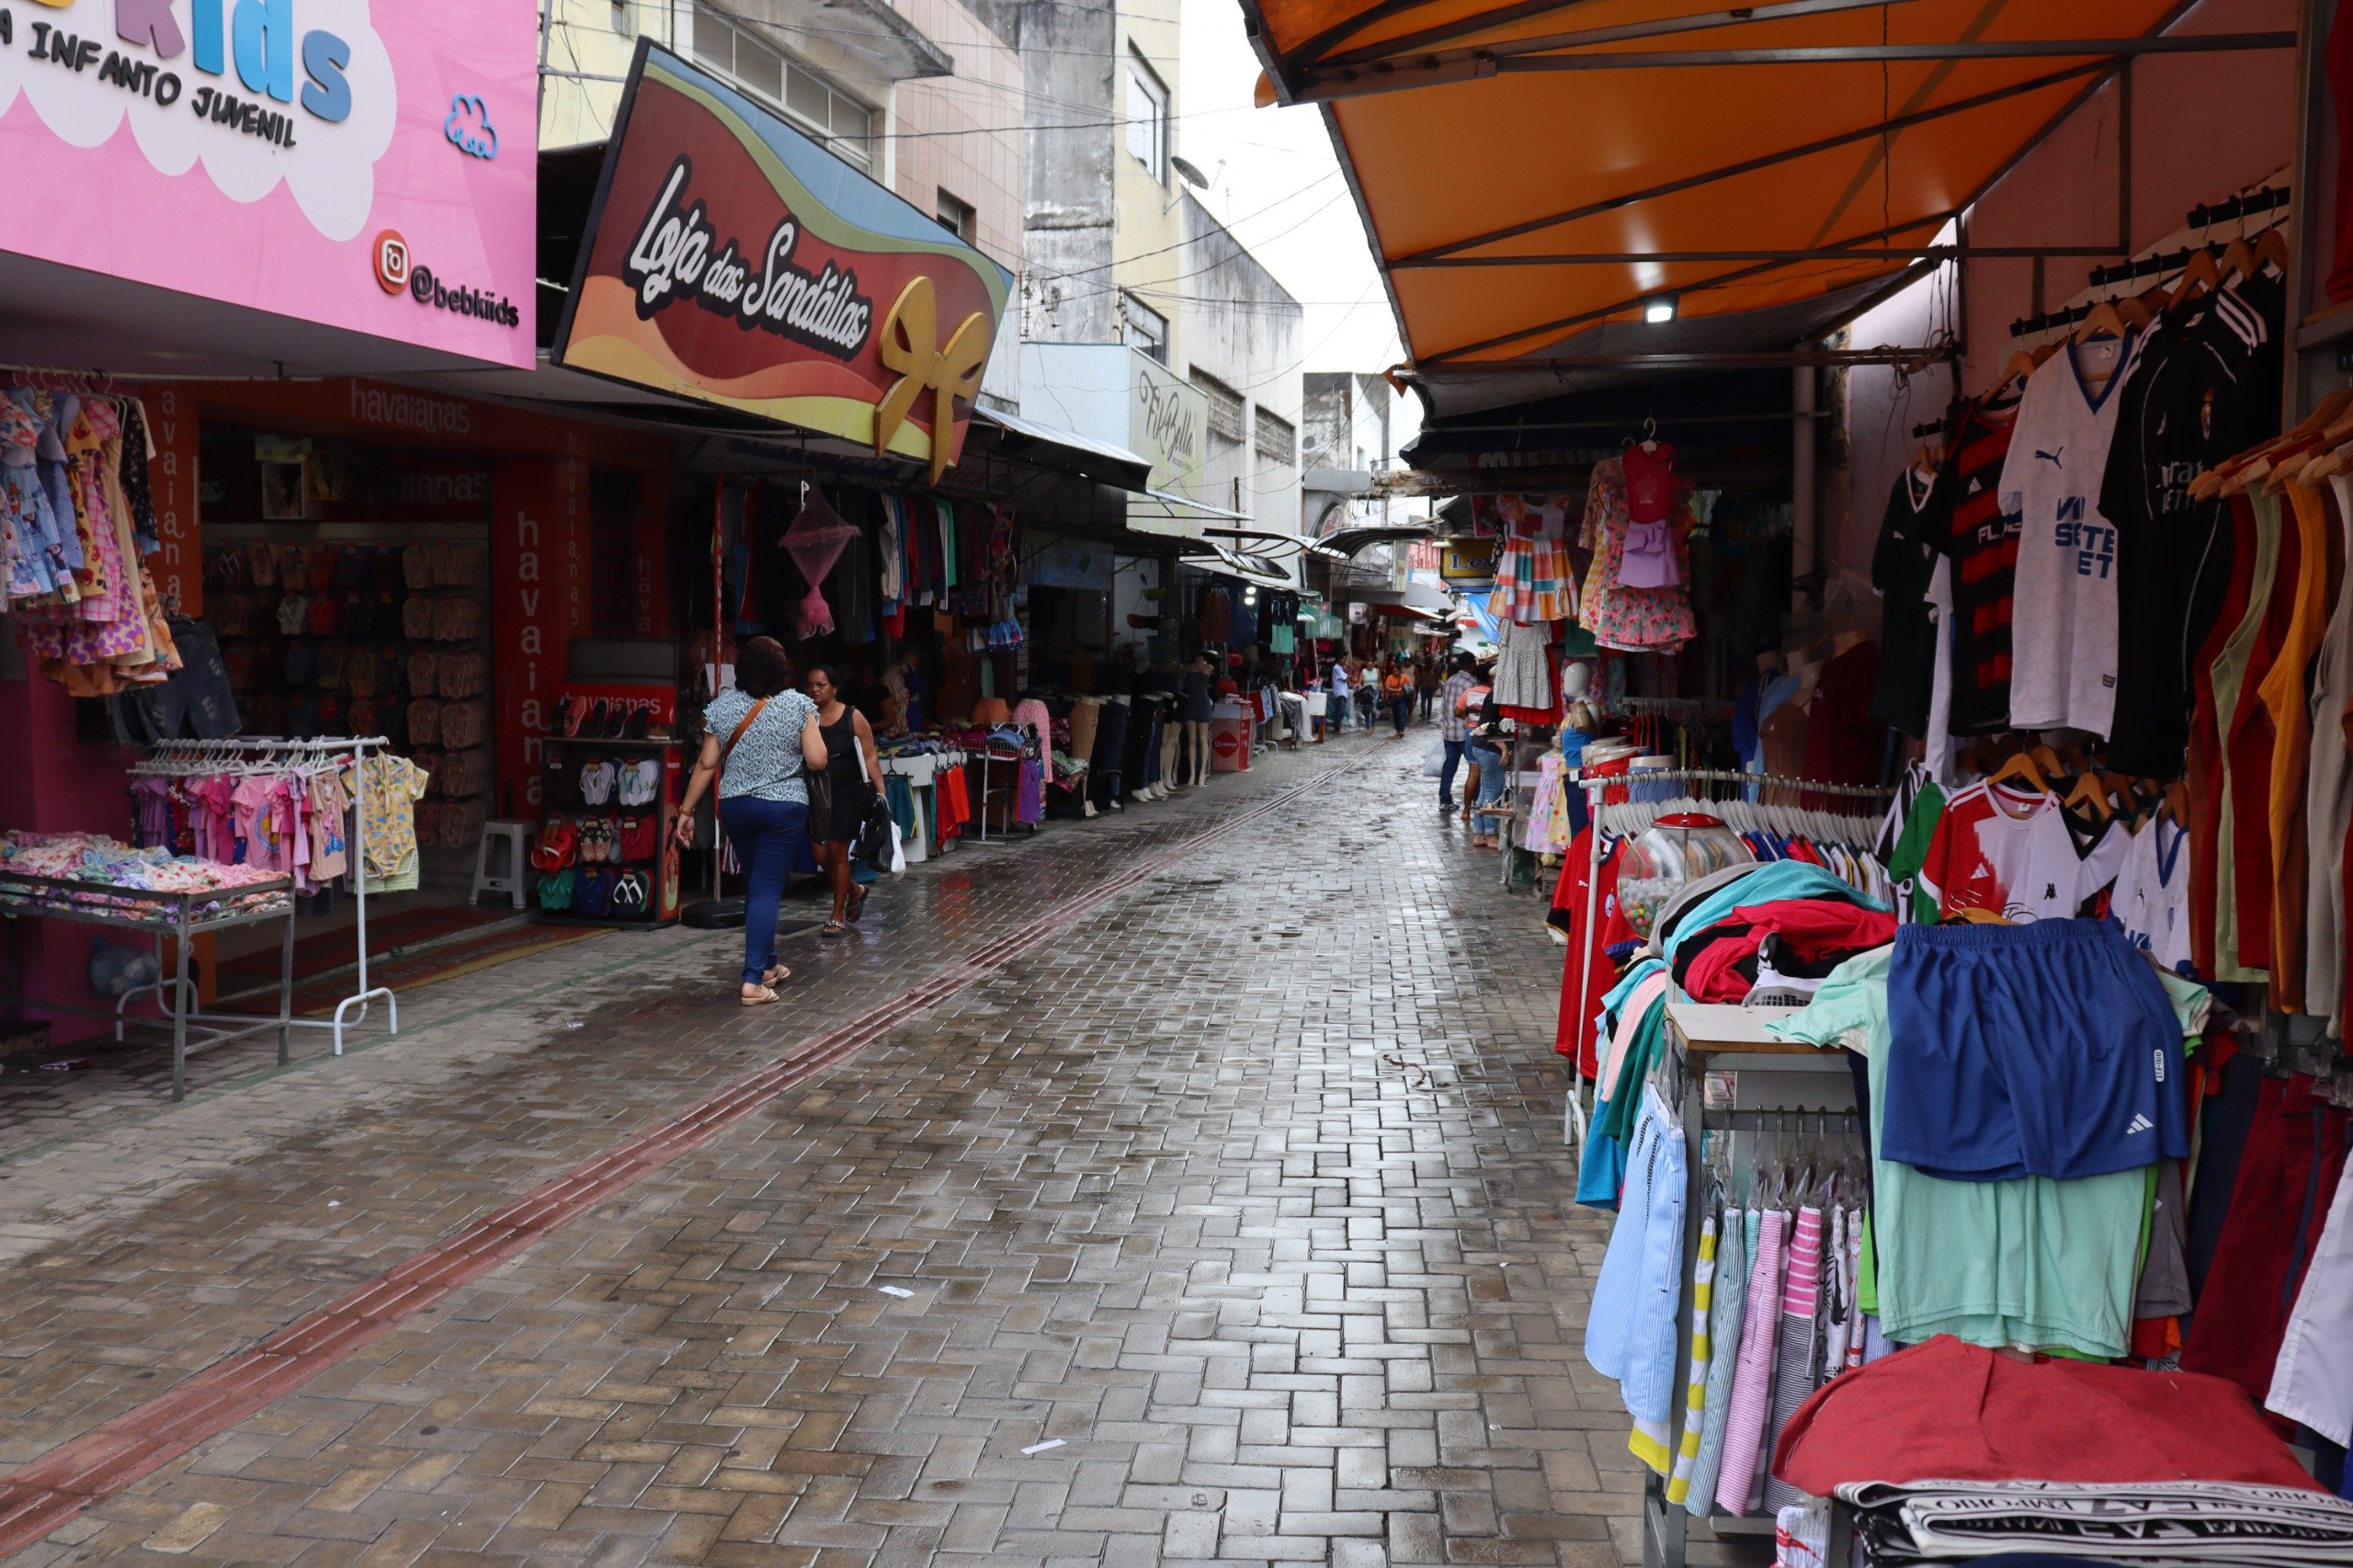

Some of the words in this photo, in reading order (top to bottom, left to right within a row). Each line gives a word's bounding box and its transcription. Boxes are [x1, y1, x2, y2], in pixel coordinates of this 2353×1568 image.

[28, 21, 182, 106] INFANTO
[192, 85, 296, 148] JUVENIL
[411, 265, 519, 327] @bebkiids
[630, 164, 706, 304] Loja
[703, 246, 745, 301] das
[742, 222, 868, 349] Sandálias
[350, 377, 471, 434] havaianas
[162, 389, 185, 610] avaiana
